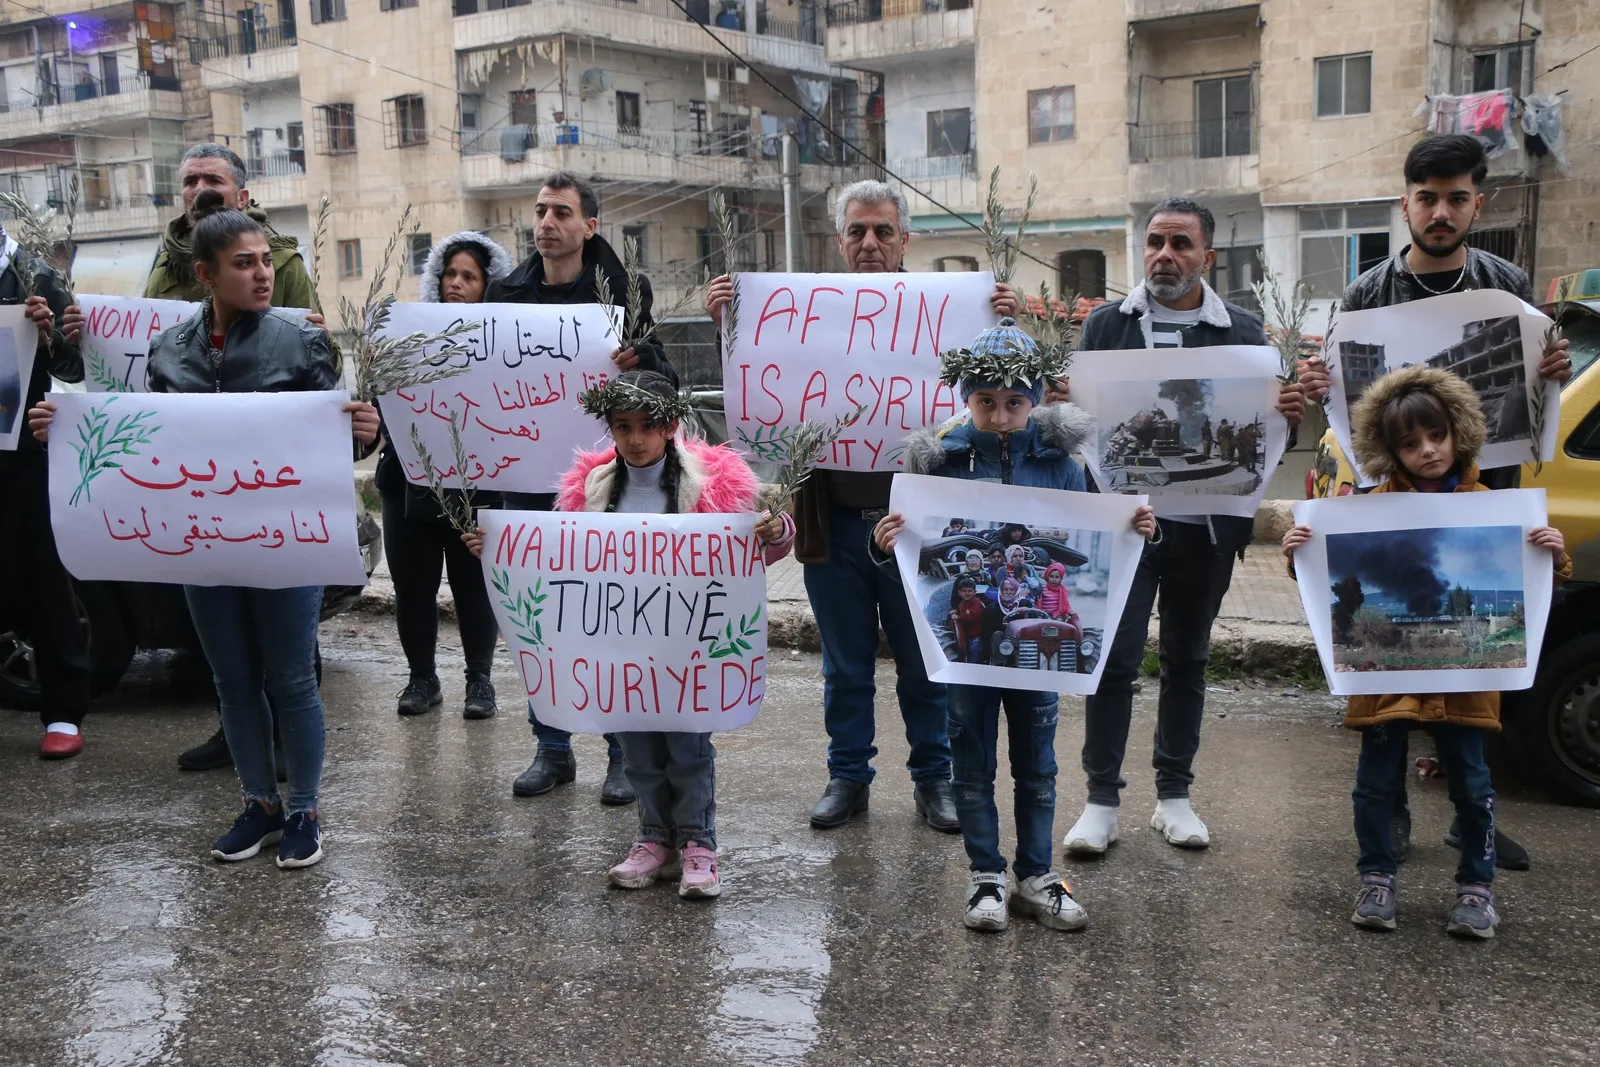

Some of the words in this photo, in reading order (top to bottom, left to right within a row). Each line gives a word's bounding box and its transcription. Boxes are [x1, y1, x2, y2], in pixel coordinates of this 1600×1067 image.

[87, 305, 141, 338] NON
[754, 281, 950, 357] AFRÎN
[503, 316, 582, 368] المحتل
[396, 386, 481, 432] آثار
[740, 363, 784, 426] IS
[800, 370, 827, 423] A
[475, 415, 540, 442] نهب
[467, 453, 521, 480] حرق
[815, 438, 884, 470] ITY
[120, 456, 302, 498] عفرين
[102, 505, 151, 541] لنا
[291, 509, 330, 544] لنا
